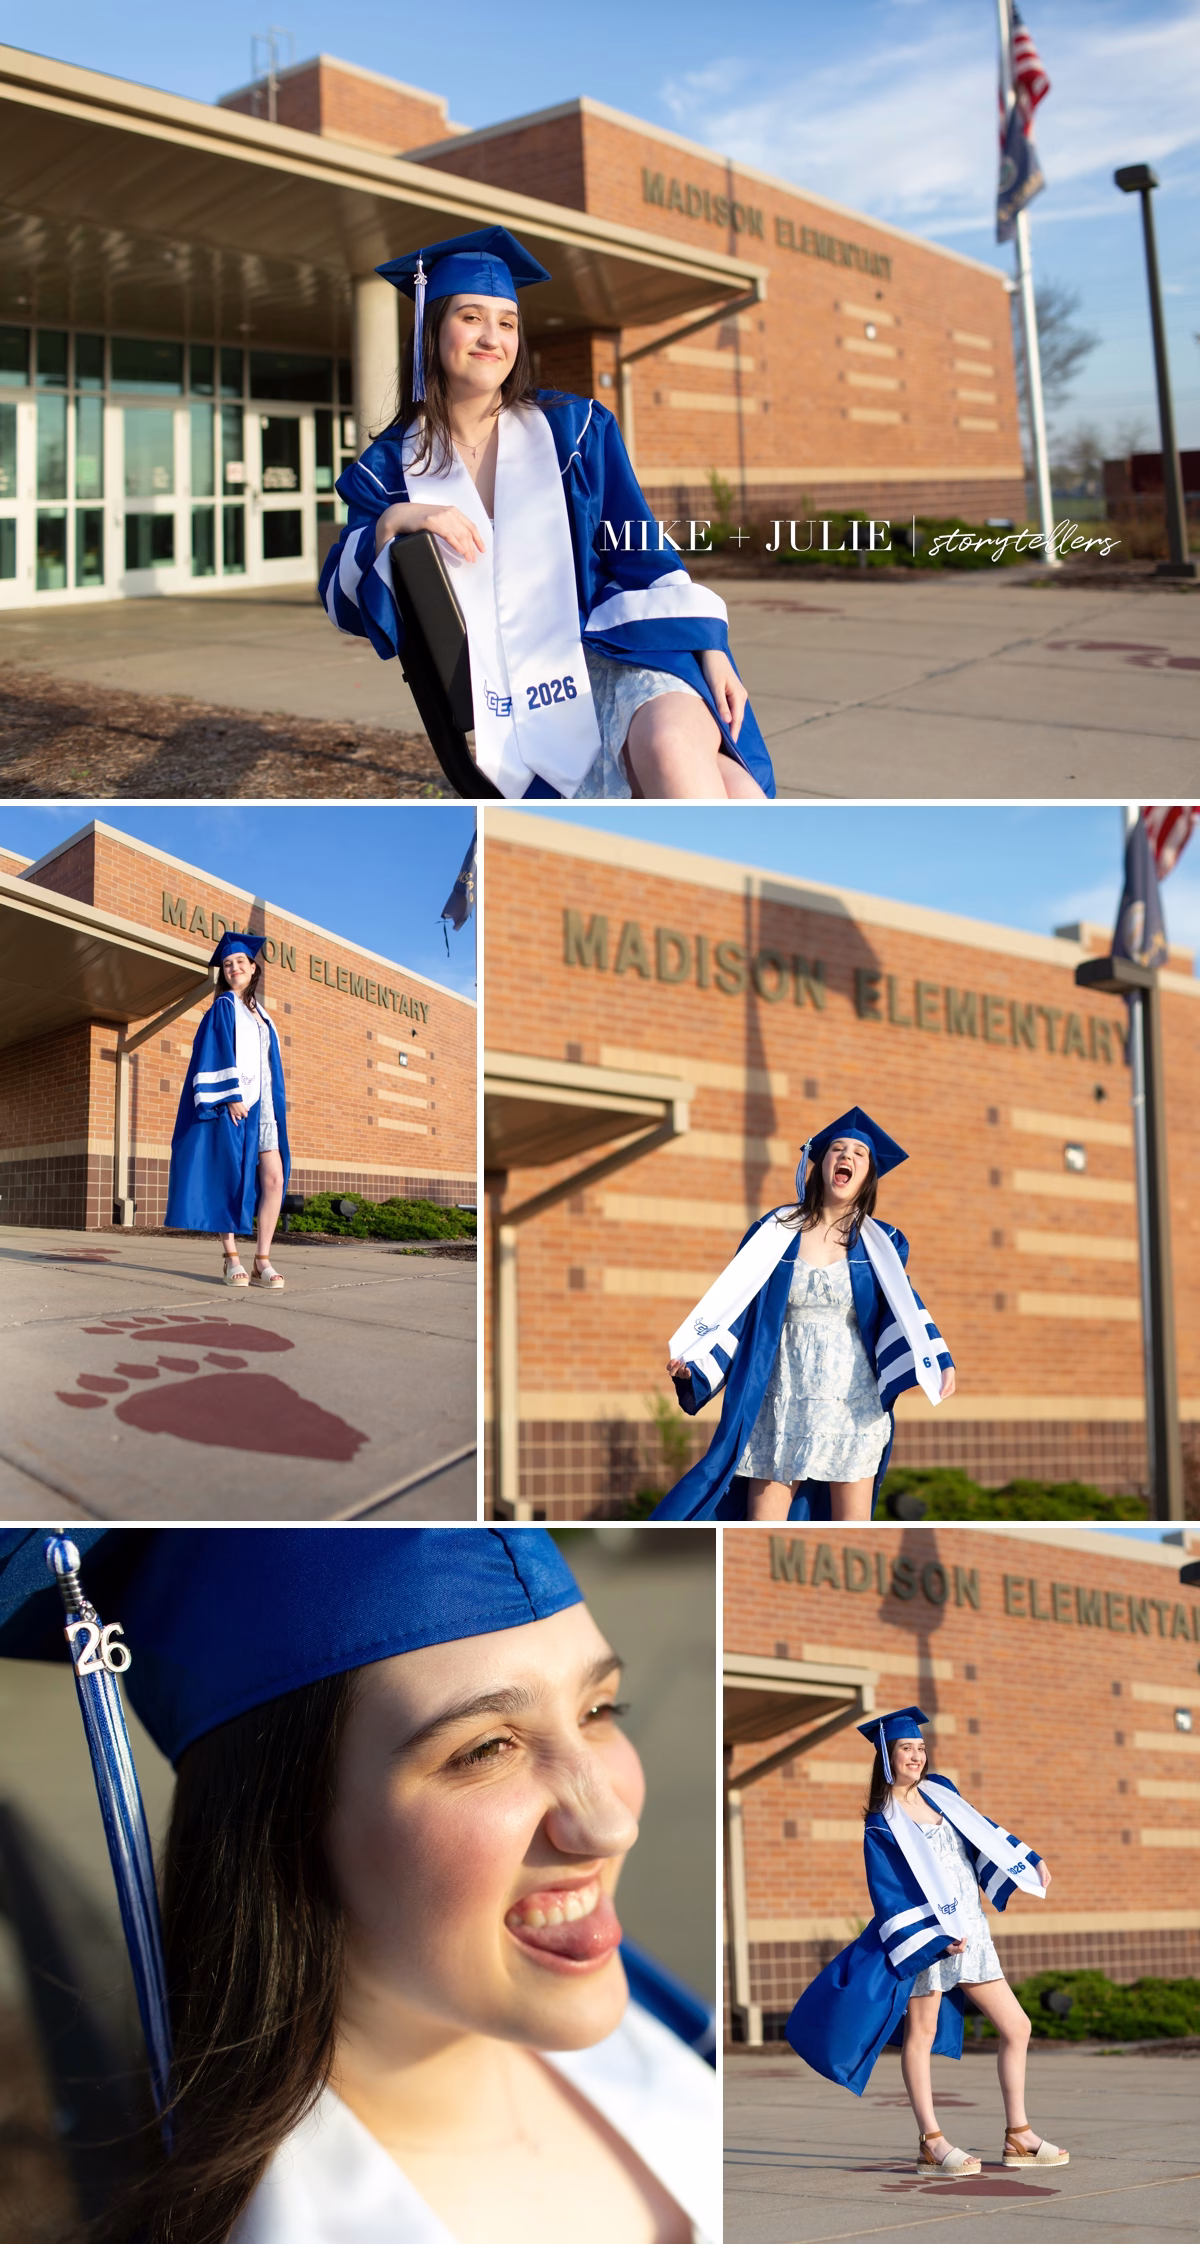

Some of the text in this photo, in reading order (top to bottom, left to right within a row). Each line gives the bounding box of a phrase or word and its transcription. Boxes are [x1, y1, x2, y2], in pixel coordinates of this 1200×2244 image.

[642, 167, 893, 280] MADISON ELEMENTARY
[414, 273, 427, 286] 26
[526, 675, 578, 711] 2026
[309, 954, 430, 1024] ELEMENTARY
[563, 907, 827, 1012] MADISON
[923, 1356, 932, 1369] 6
[769, 1534, 981, 1611] MADISON
[64, 1620, 132, 1677] 26
